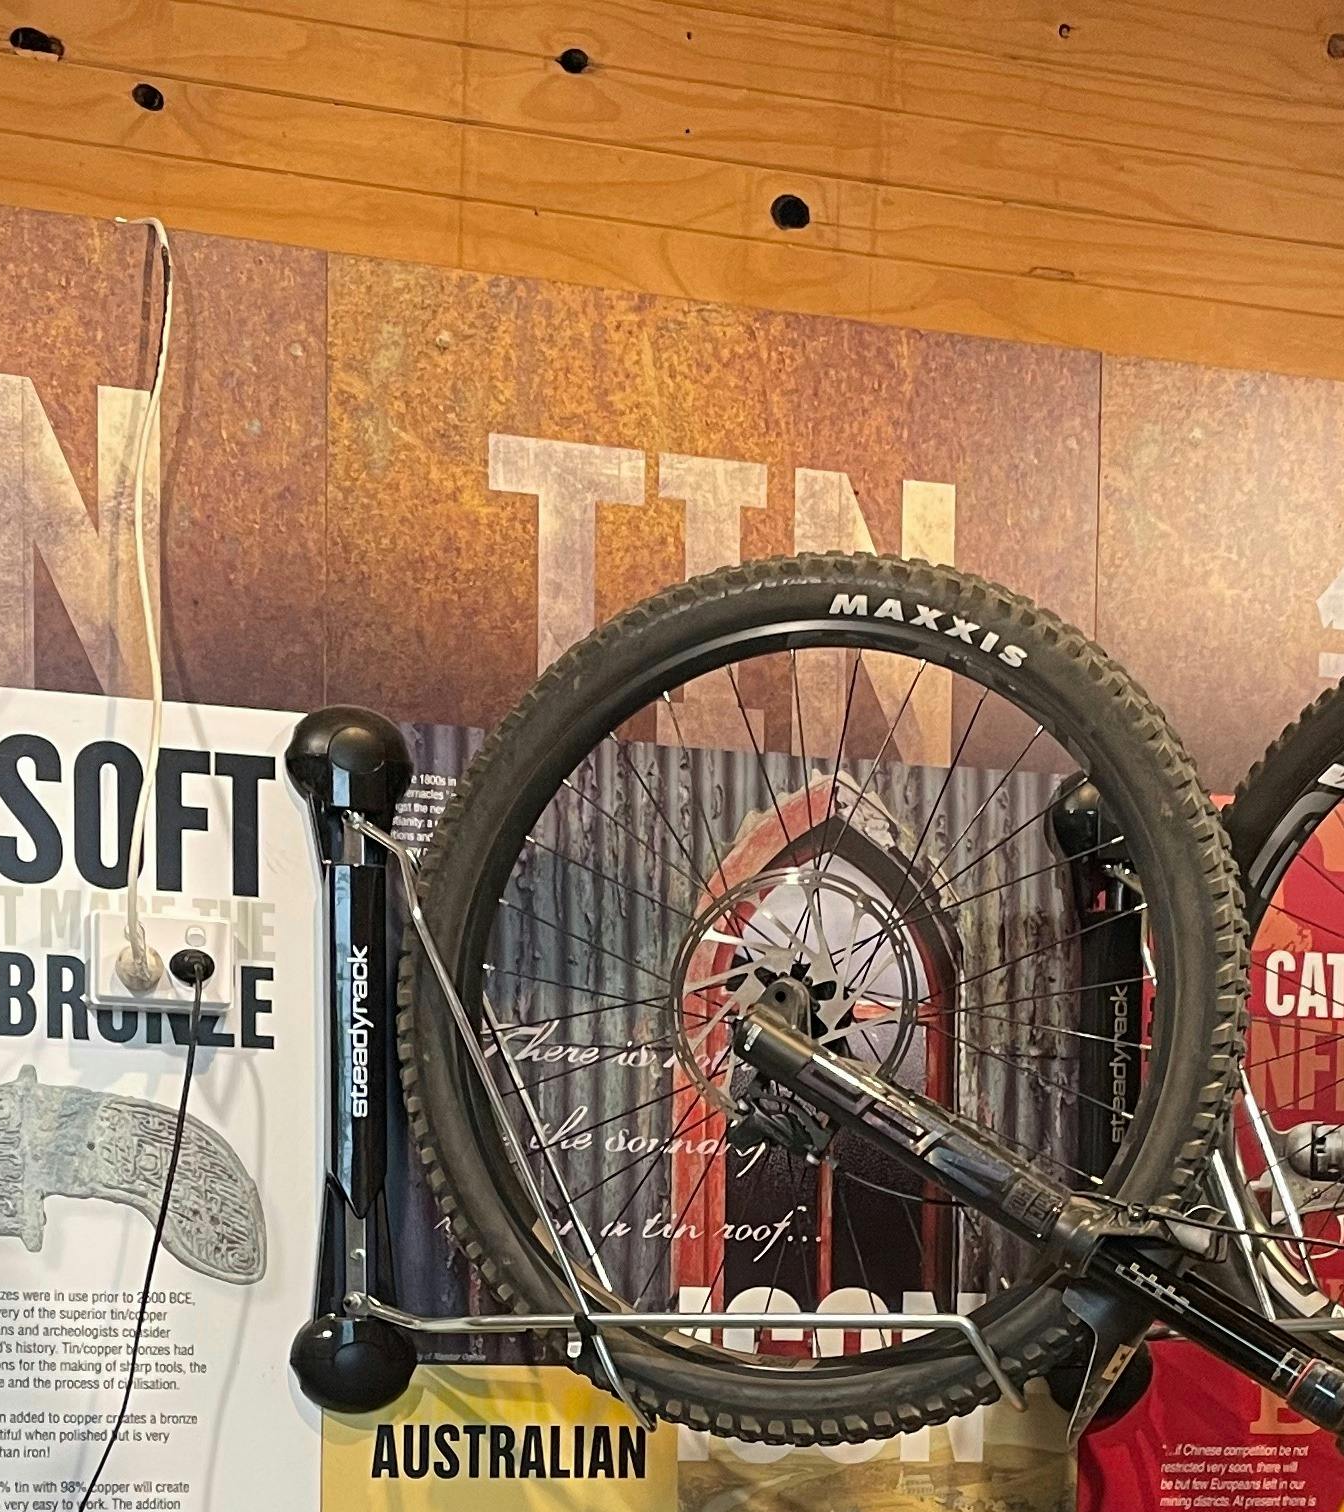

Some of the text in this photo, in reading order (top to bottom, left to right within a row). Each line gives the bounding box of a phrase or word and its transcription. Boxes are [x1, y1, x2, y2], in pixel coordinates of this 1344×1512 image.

[488, 433, 956, 767] TIN
[829, 593, 1028, 670] MAXXIS
[347, 944, 374, 1118] steadyrack
[480, 1020, 656, 1068] There is
[1109, 985, 1132, 1144] steadyrack
[530, 1105, 593, 1151] the
[600, 1217, 631, 1239] a
[642, 1213, 705, 1240] tin
[23, 1291, 50, 1302] were
[54, 1289, 64, 1302] in
[69, 1292, 88, 1302] use
[92, 1289, 119, 1306] prior
[123, 1290, 133, 1303] to
[169, 1290, 195, 1307] BCE,
[23, 1305, 34, 1319] of
[38, 1306, 56, 1319] the
[59, 1306, 107, 1322] superior
[18, 1323, 39, 1336] and
[43, 1323, 119, 1340] archeologists
[10, 1410, 45, 1423] added
[48, 1410, 60, 1423] to
[63, 1413, 103, 1426] copper
[150, 1414, 156, 1424] a
[160, 1411, 197, 1424] bronze
[372, 1423, 647, 1480] AUSTRALIAN
